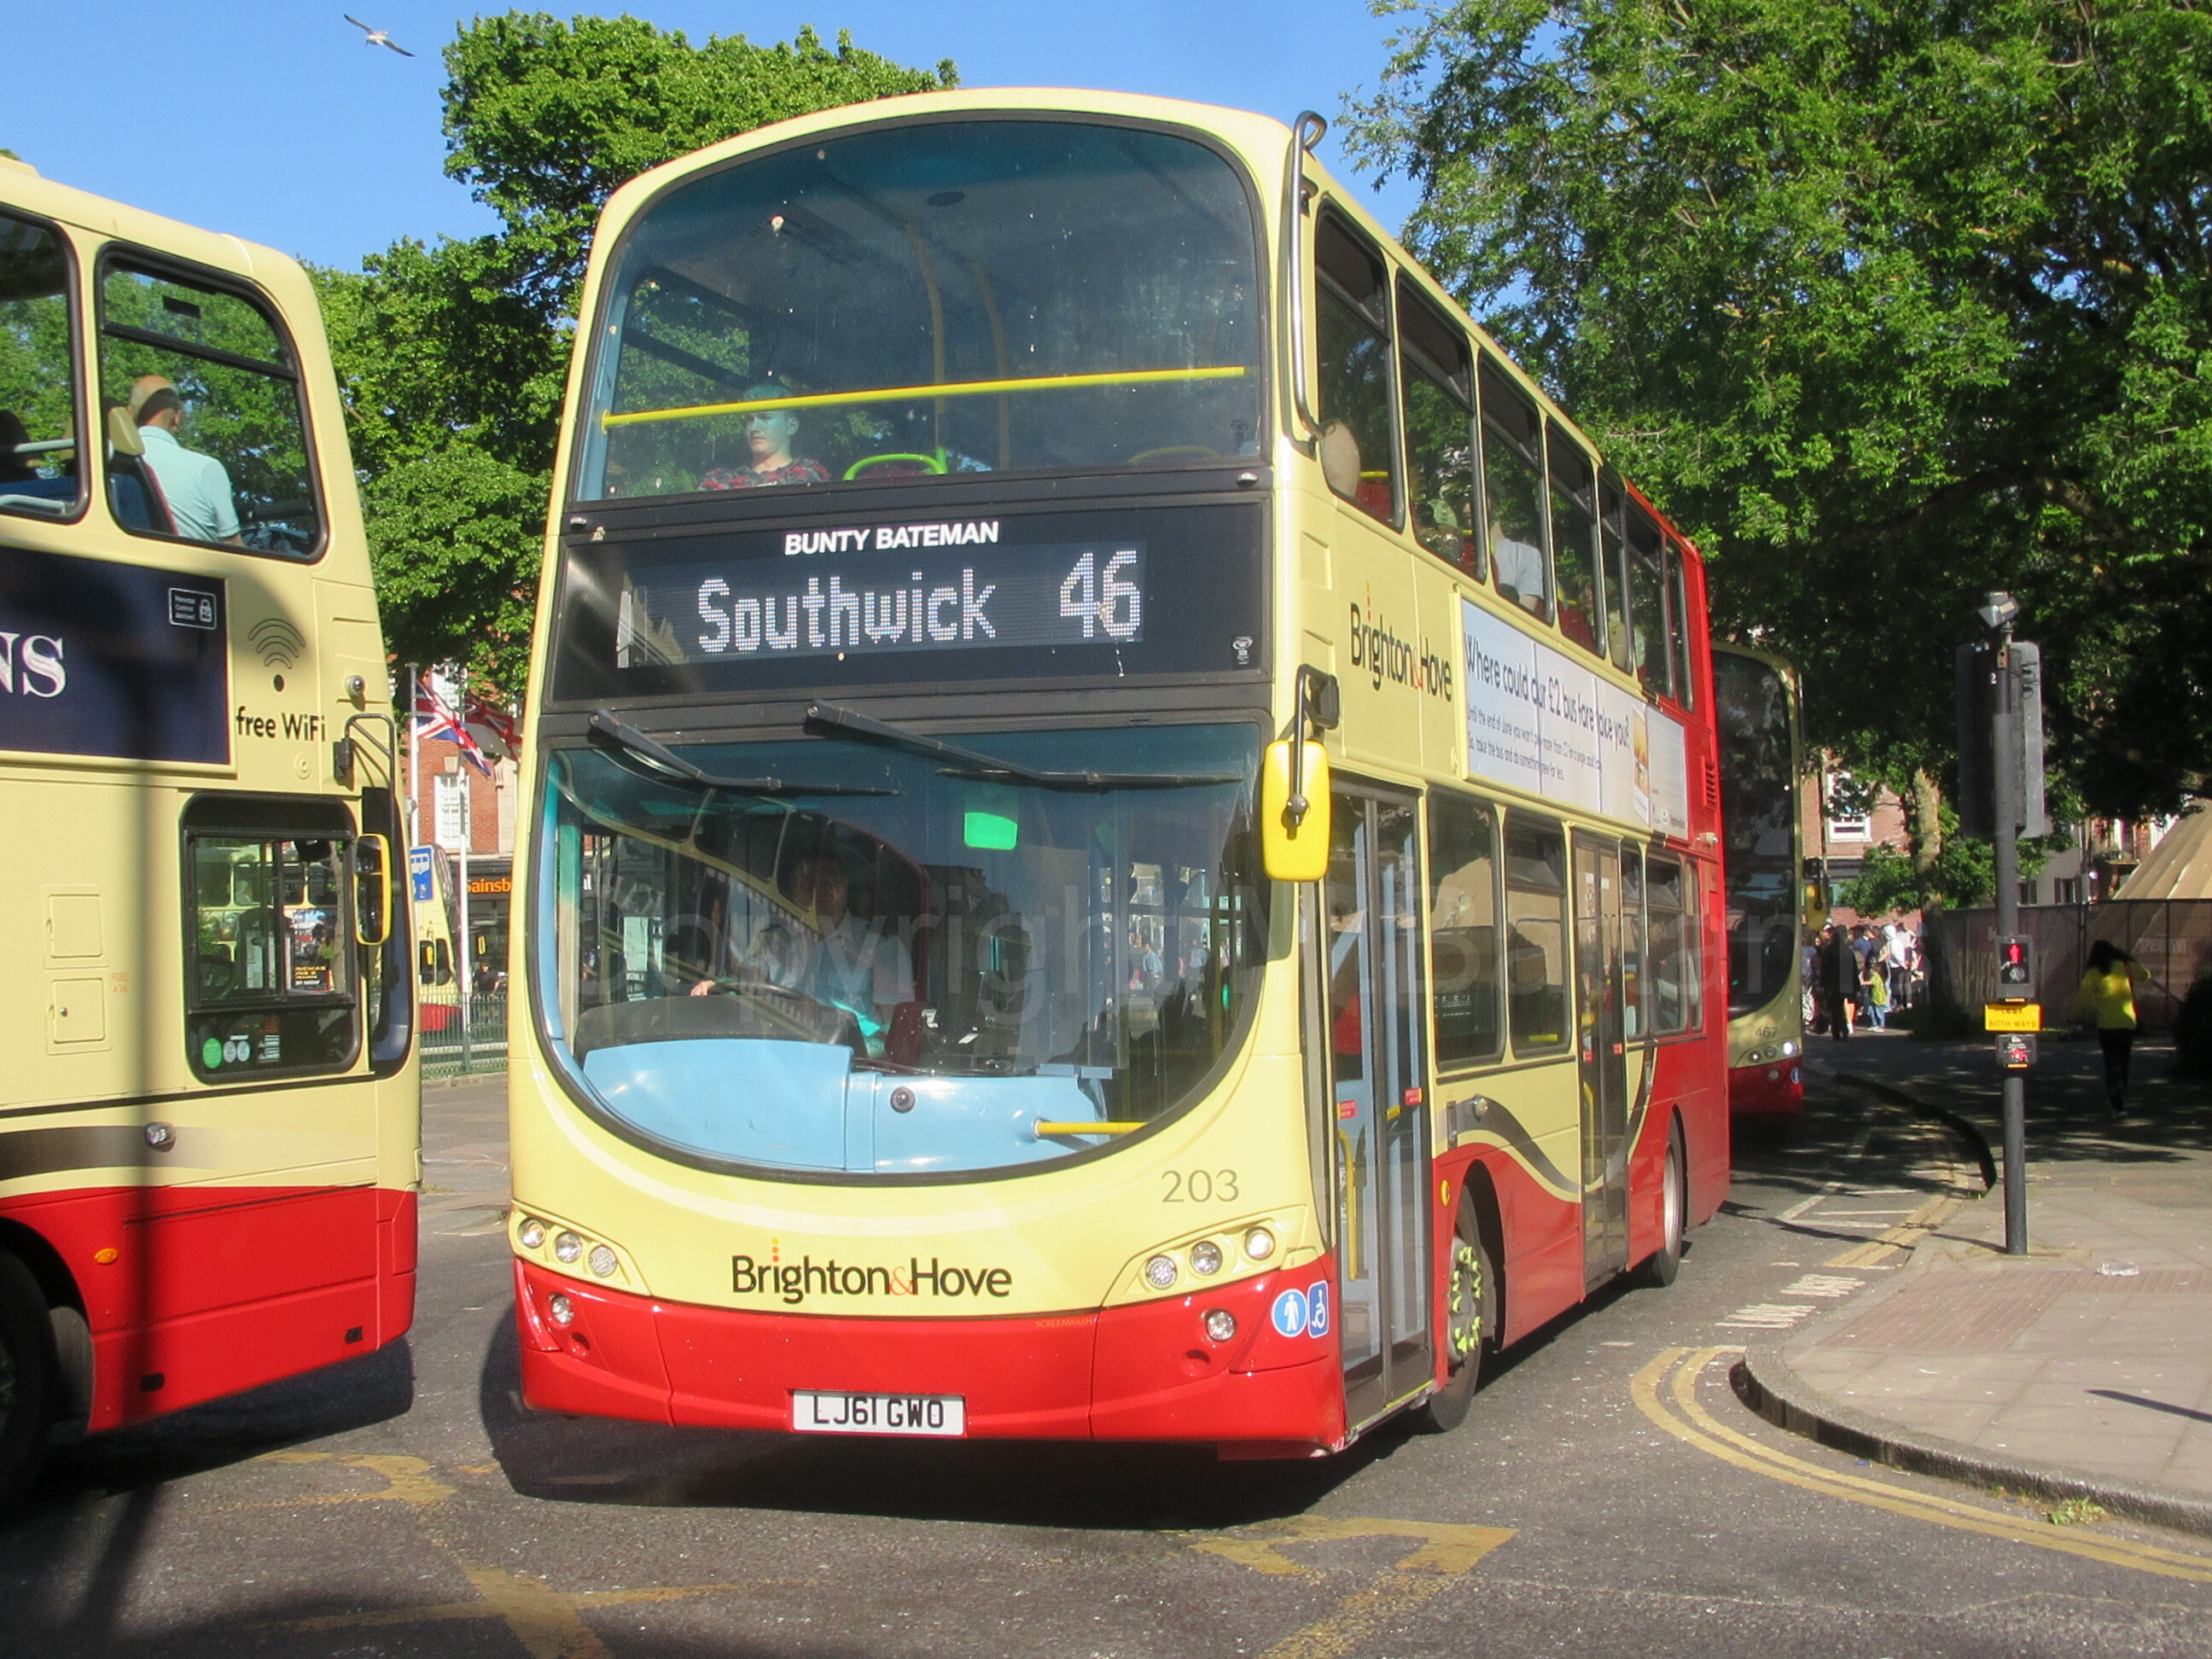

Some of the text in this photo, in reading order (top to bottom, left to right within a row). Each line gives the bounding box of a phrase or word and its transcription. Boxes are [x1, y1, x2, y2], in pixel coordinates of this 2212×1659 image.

[784, 521, 999, 555] BUNTY BATEMAN
[697, 550, 1142, 654] Southwick 46
[1464, 632, 1500, 690] Where
[1503, 662, 1528, 701] could
[1531, 678, 1545, 710] our
[1549, 676, 1561, 717] £2
[1562, 684, 1577, 724] bus
[1577, 692, 1594, 733] fare
[1613, 715, 1630, 752] you?
[236, 706, 326, 742] free WiFi
[1755, 1027, 1778, 1038] 467
[1989, 1020, 2036, 1028] BOTH WAYS
[1161, 1168, 1240, 1203] 203
[731, 1237, 1013, 1304] Brighton&Hove
[1035, 1318, 1093, 1328] SCREENWASH
[813, 1395, 945, 1429] LJ61 GWO
